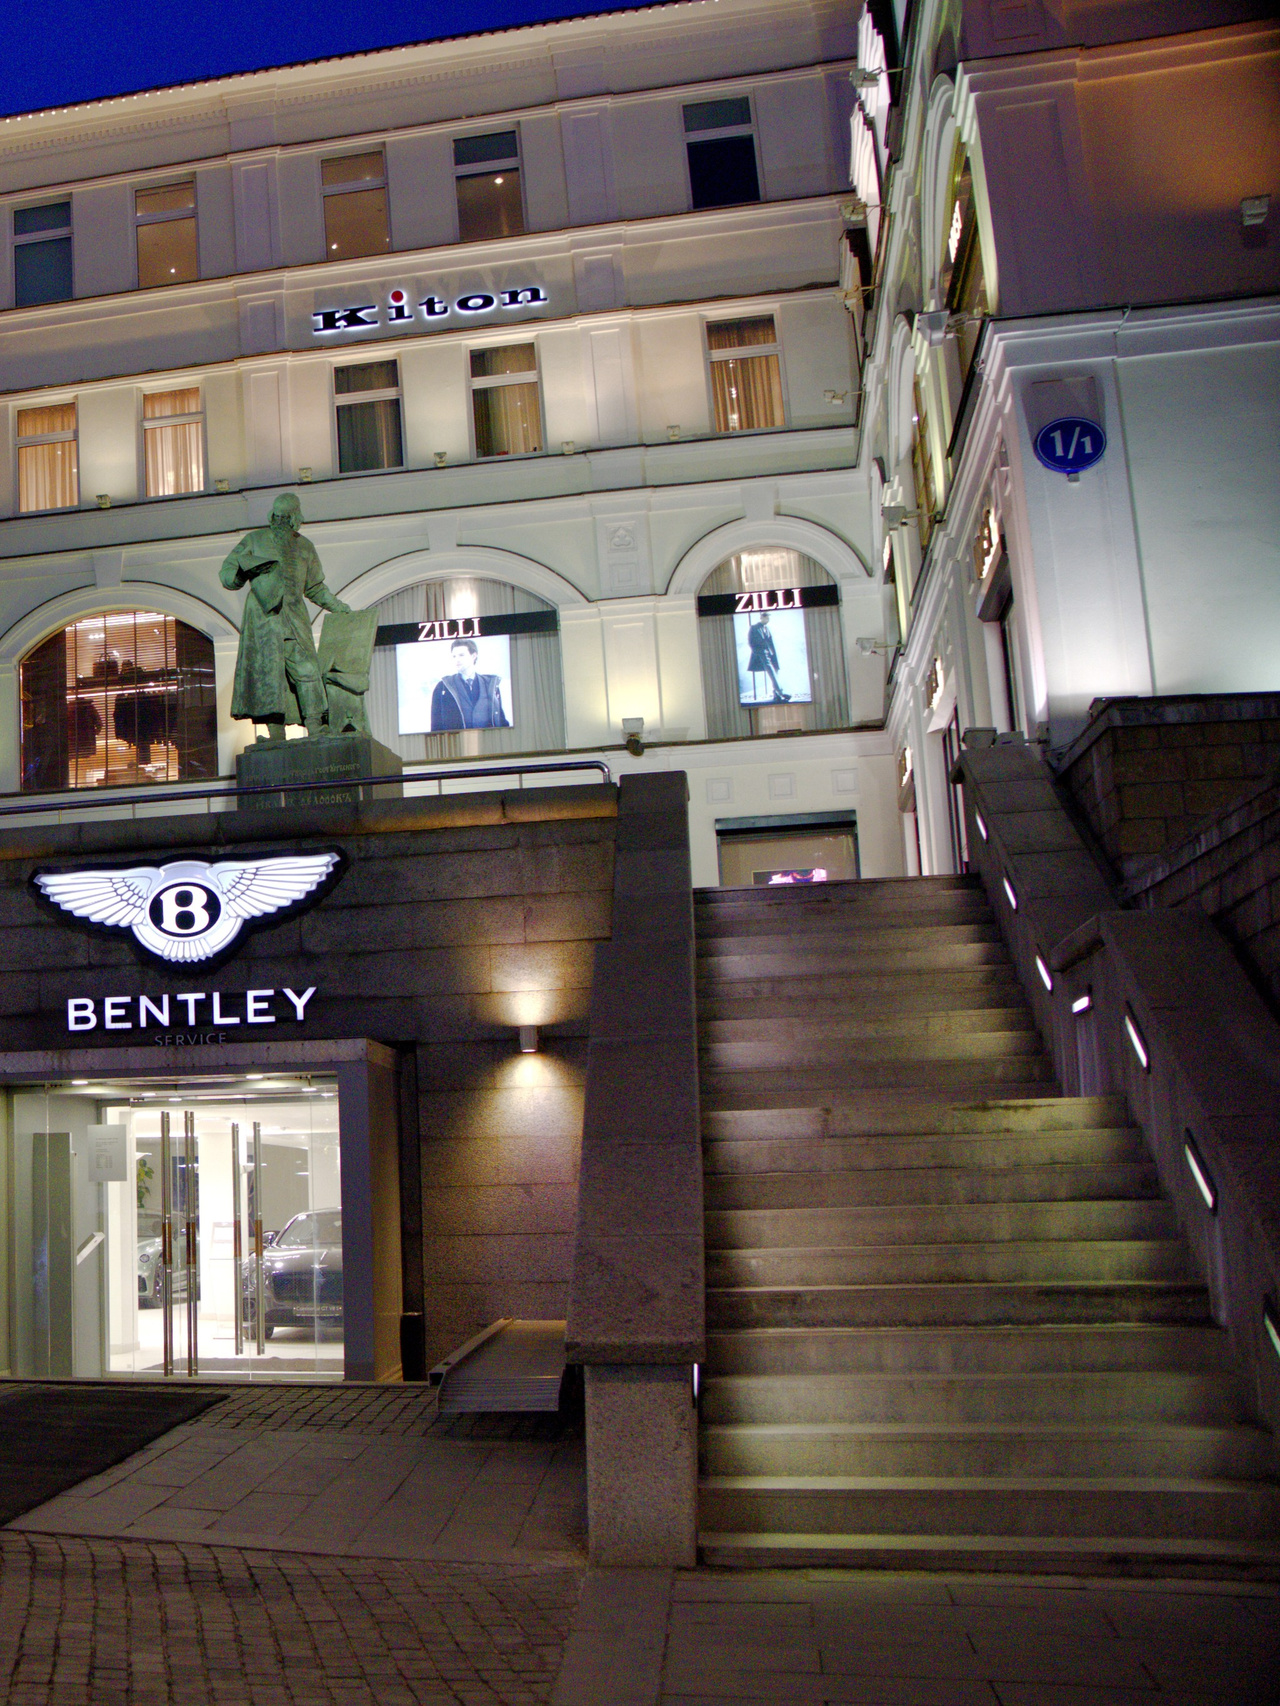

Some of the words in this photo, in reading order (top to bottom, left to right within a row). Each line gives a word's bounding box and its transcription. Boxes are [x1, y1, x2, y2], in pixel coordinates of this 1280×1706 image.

[312, 288, 548, 334] Kiton
[1049, 426, 1094, 460] 1/1
[734, 588, 803, 613] ZILLI
[417, 617, 482, 642] ZILLI
[159, 885, 210, 934] B
[67, 986, 318, 1031] BENTLEY
[154, 1032, 227, 1047] SERVICE
